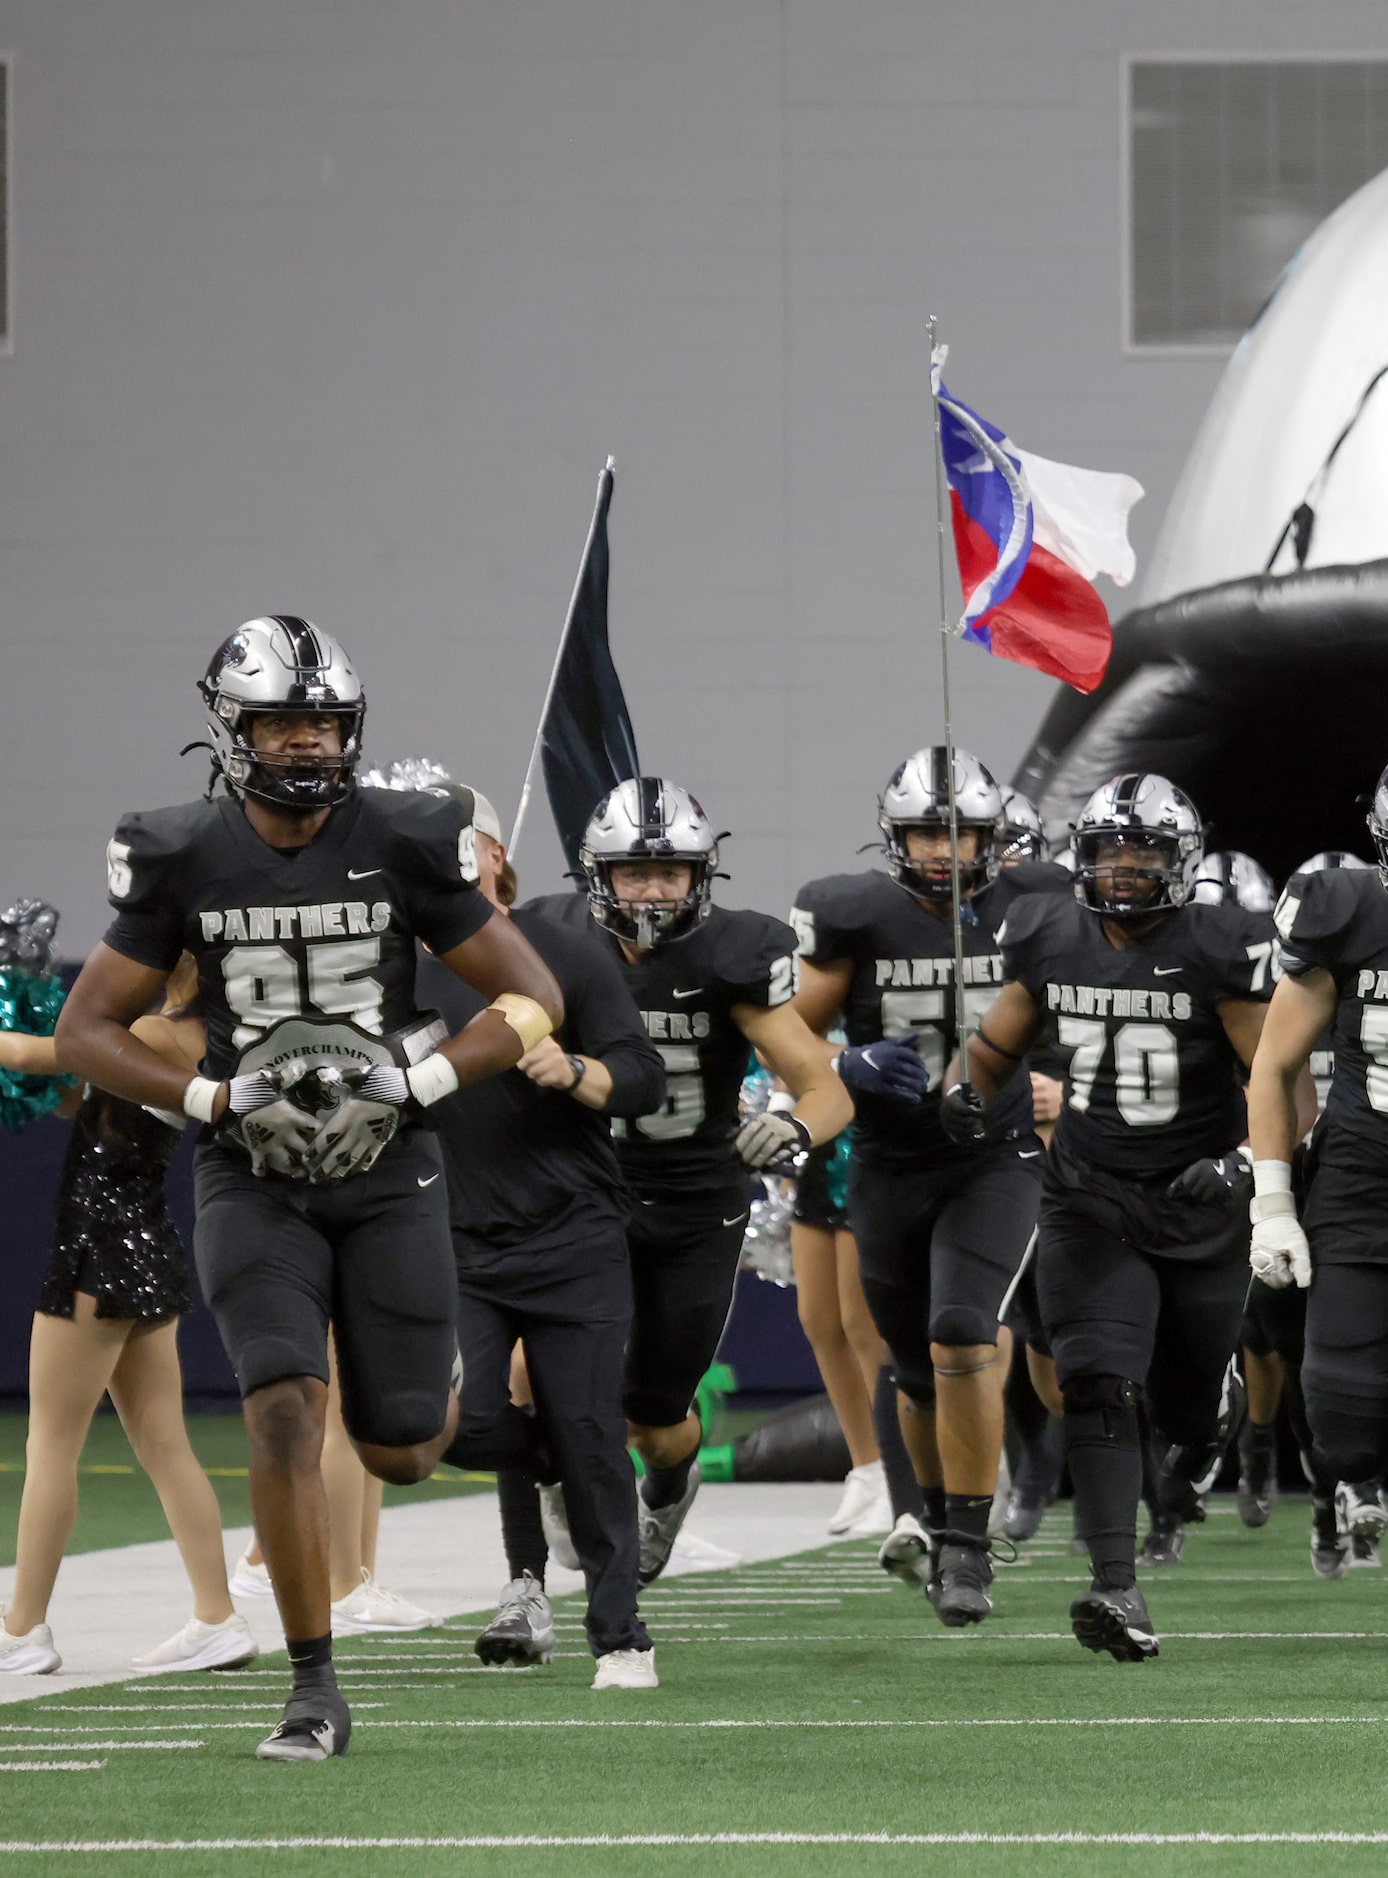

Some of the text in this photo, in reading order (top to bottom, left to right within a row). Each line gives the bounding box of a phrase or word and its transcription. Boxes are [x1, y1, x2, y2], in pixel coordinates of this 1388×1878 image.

[199, 901, 391, 942] PANTHERS
[1046, 983, 1192, 1021] PANTHERS
[1058, 1015, 1180, 1127] 70
